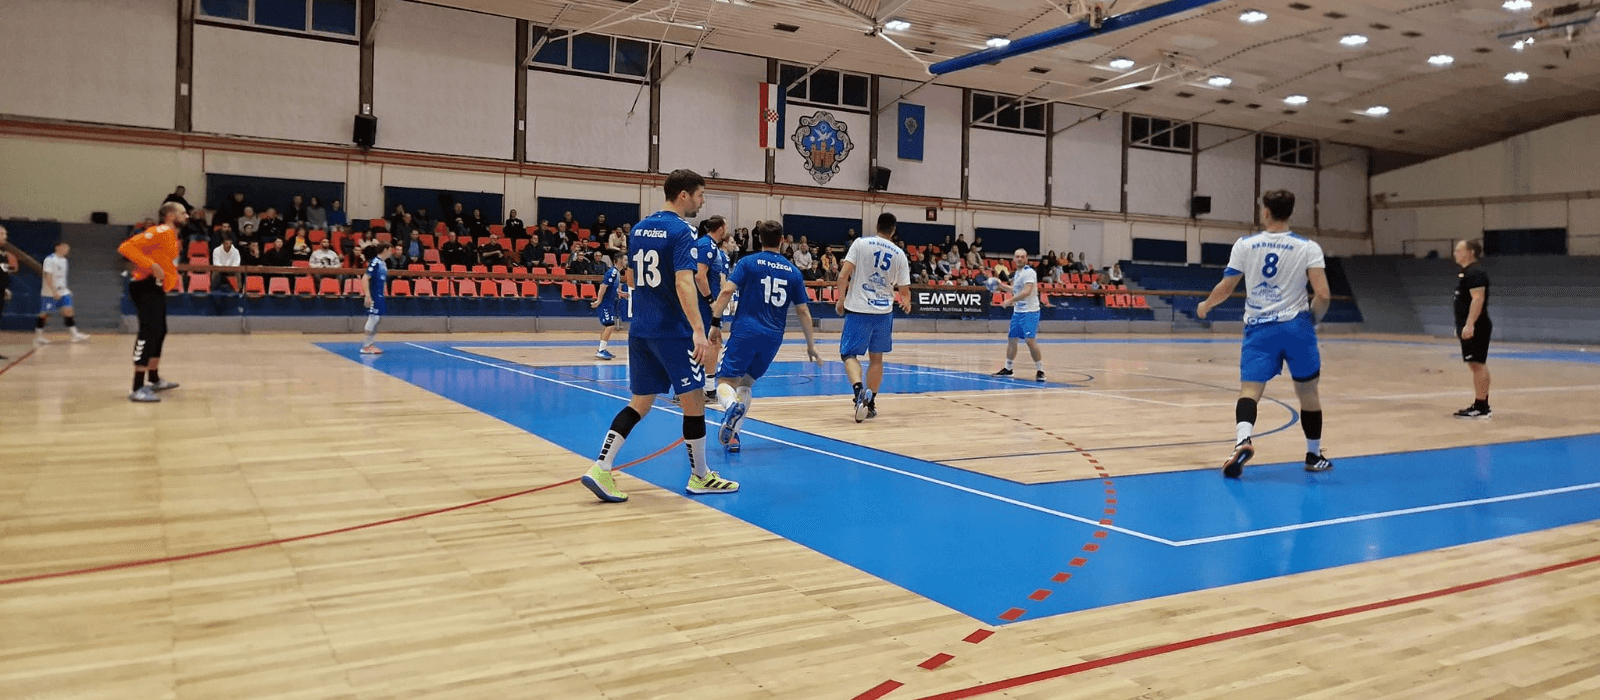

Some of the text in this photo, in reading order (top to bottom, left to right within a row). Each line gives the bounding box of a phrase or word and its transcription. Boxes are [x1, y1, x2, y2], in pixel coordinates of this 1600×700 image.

[634, 227, 667, 239] RK POŽEGA
[632, 248, 662, 288] 13
[873, 250, 893, 271] 15
[1261, 252, 1279, 278] 8
[760, 275, 788, 308] 15
[918, 292, 982, 306] EMPWR
